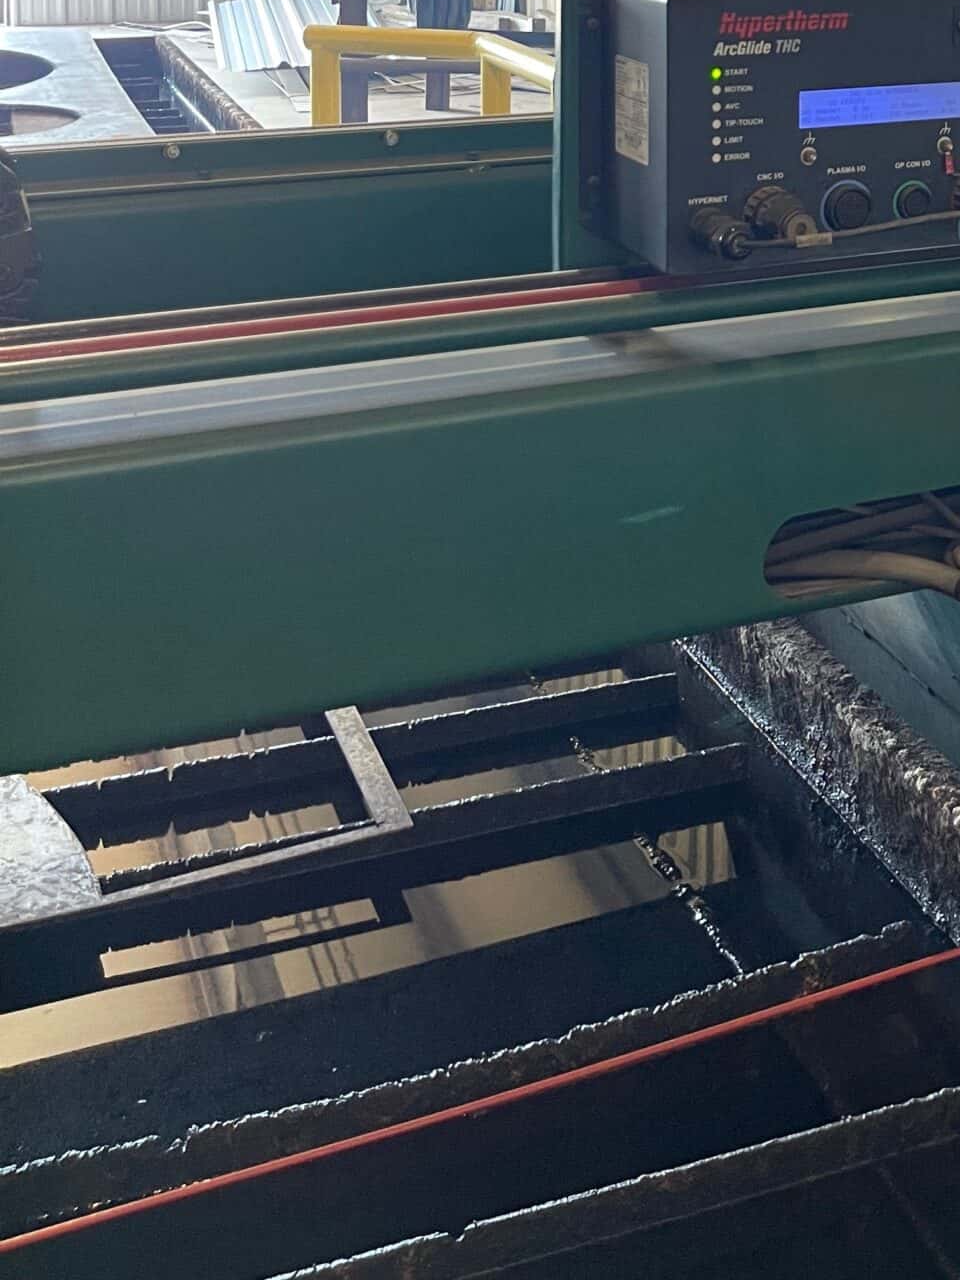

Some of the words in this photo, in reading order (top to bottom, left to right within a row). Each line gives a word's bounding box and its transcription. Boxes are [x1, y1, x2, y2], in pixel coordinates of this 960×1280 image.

[719, 11, 849, 37] Hypertherm
[713, 40, 772, 57] ArcGlide
[775, 38, 801, 54] THC
[724, 68, 748, 76] START
[724, 85, 753, 93] MOTION
[724, 136, 743, 144] LIMIT
[724, 152, 750, 161] ERROR
[827, 166, 856, 175] PLASMA
[756, 173, 773, 181] CNC
[688, 195, 728, 206] HYPERNET
